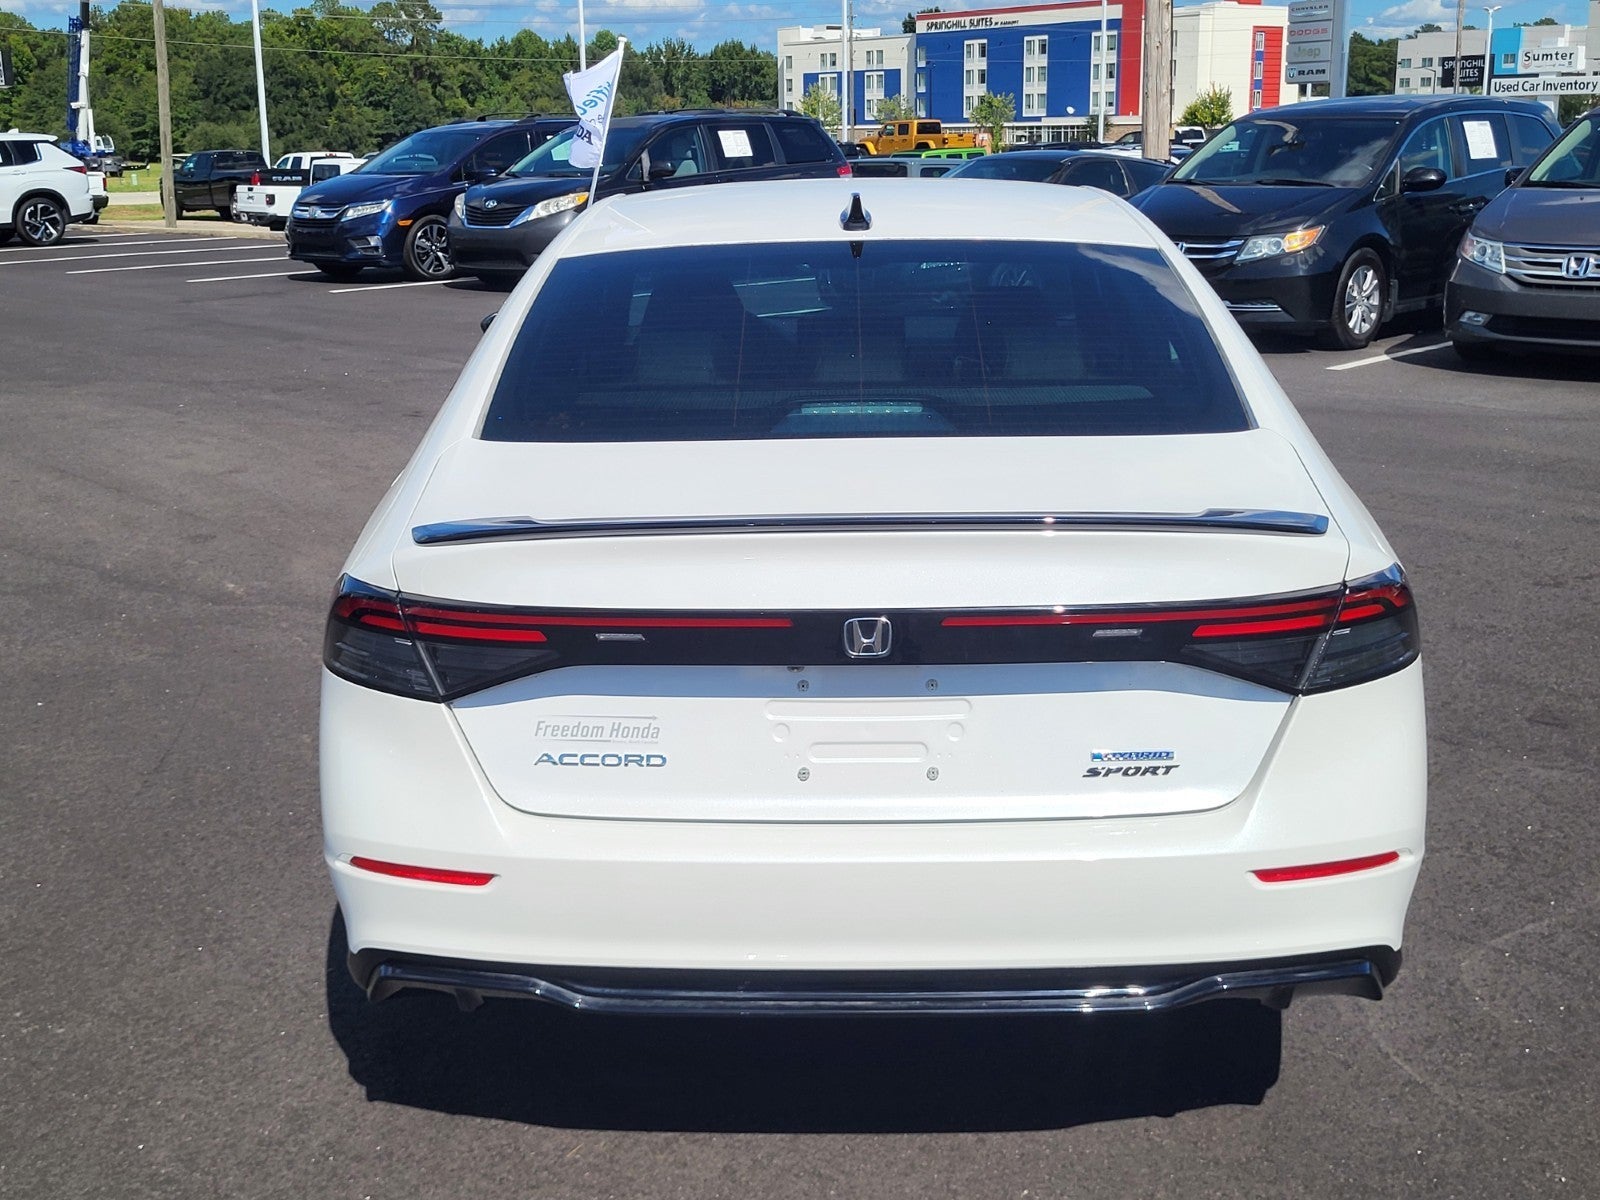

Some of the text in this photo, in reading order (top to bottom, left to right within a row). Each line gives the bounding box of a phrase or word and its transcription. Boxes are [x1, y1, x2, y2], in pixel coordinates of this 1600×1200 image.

[926, 19, 967, 31] SPRINGHILL
[969, 17, 993, 29] SUITES
[1289, 28, 1328, 36] DODGE
[1293, 46, 1321, 58] Jeep
[1524, 51, 1574, 62] Sumter
[1494, 80, 1598, 93] Used Car Inventory
[535, 720, 660, 739] Freedom Honda
[534, 753, 667, 767] ACCORD
[1082, 765, 1180, 777] SPORT
